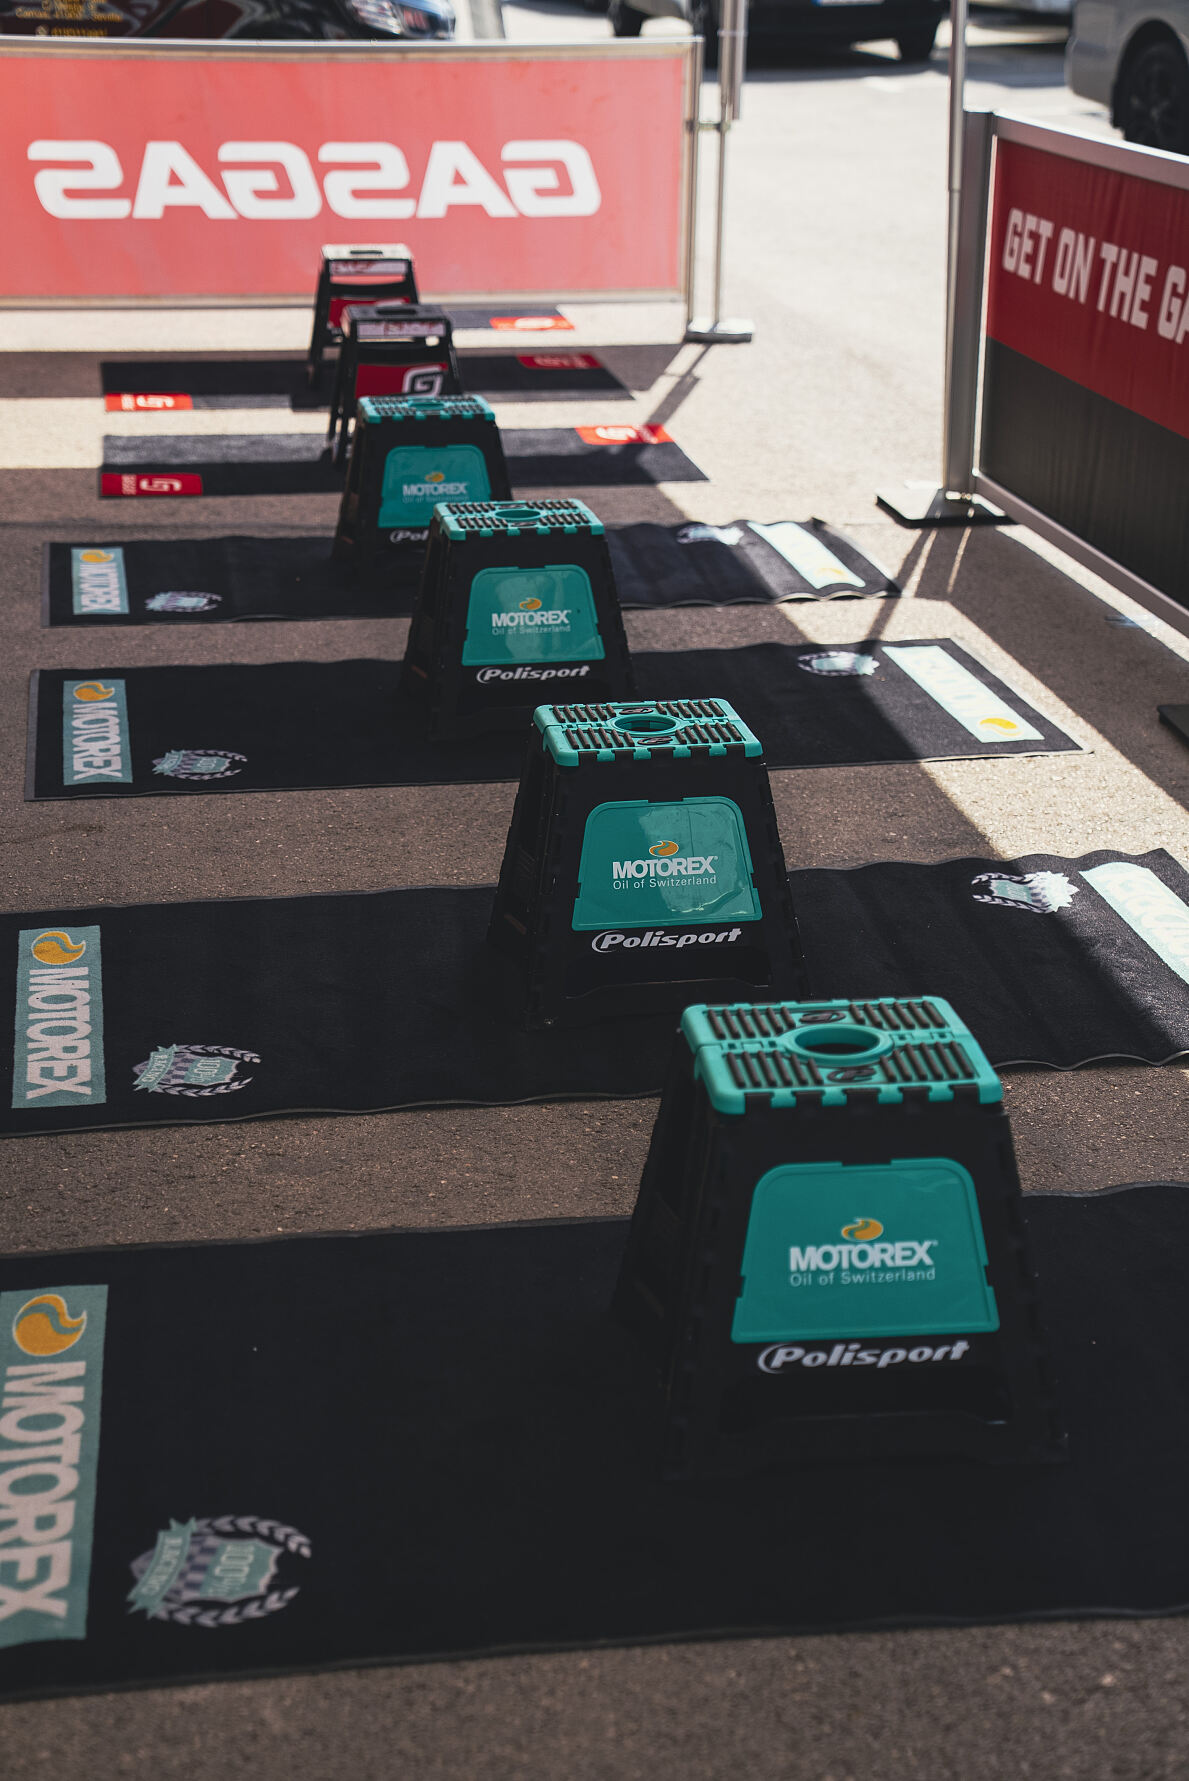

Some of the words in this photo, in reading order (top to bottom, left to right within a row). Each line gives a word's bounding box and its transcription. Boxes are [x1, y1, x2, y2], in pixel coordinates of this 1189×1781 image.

[1002, 207, 1055, 286] GET
[1052, 226, 1096, 305] ON
[1097, 240, 1159, 331] THE
[402, 483, 468, 496] MOTOREX
[491, 610, 570, 628] MOTOREX
[492, 627, 506, 636] Oil
[507, 626, 518, 635] of
[519, 624, 571, 635] Switzerland
[482, 665, 590, 683] Polisport
[71, 702, 123, 780] MOTOREX
[612, 855, 715, 879] MOTOREX
[613, 879, 629, 890] Oil
[633, 878, 645, 889] of
[649, 875, 717, 888] Switzerland
[598, 928, 742, 948] Polisport
[26, 967, 93, 1100] MOTOREX
[789, 1240, 934, 1272] MOTOREX
[790, 1272, 812, 1287] Oil
[819, 1271, 834, 1286] of
[840, 1267, 936, 1285] Switzerland
[768, 1340, 970, 1369] Polisport
[0, 1361, 87, 1620] MOTOREX
